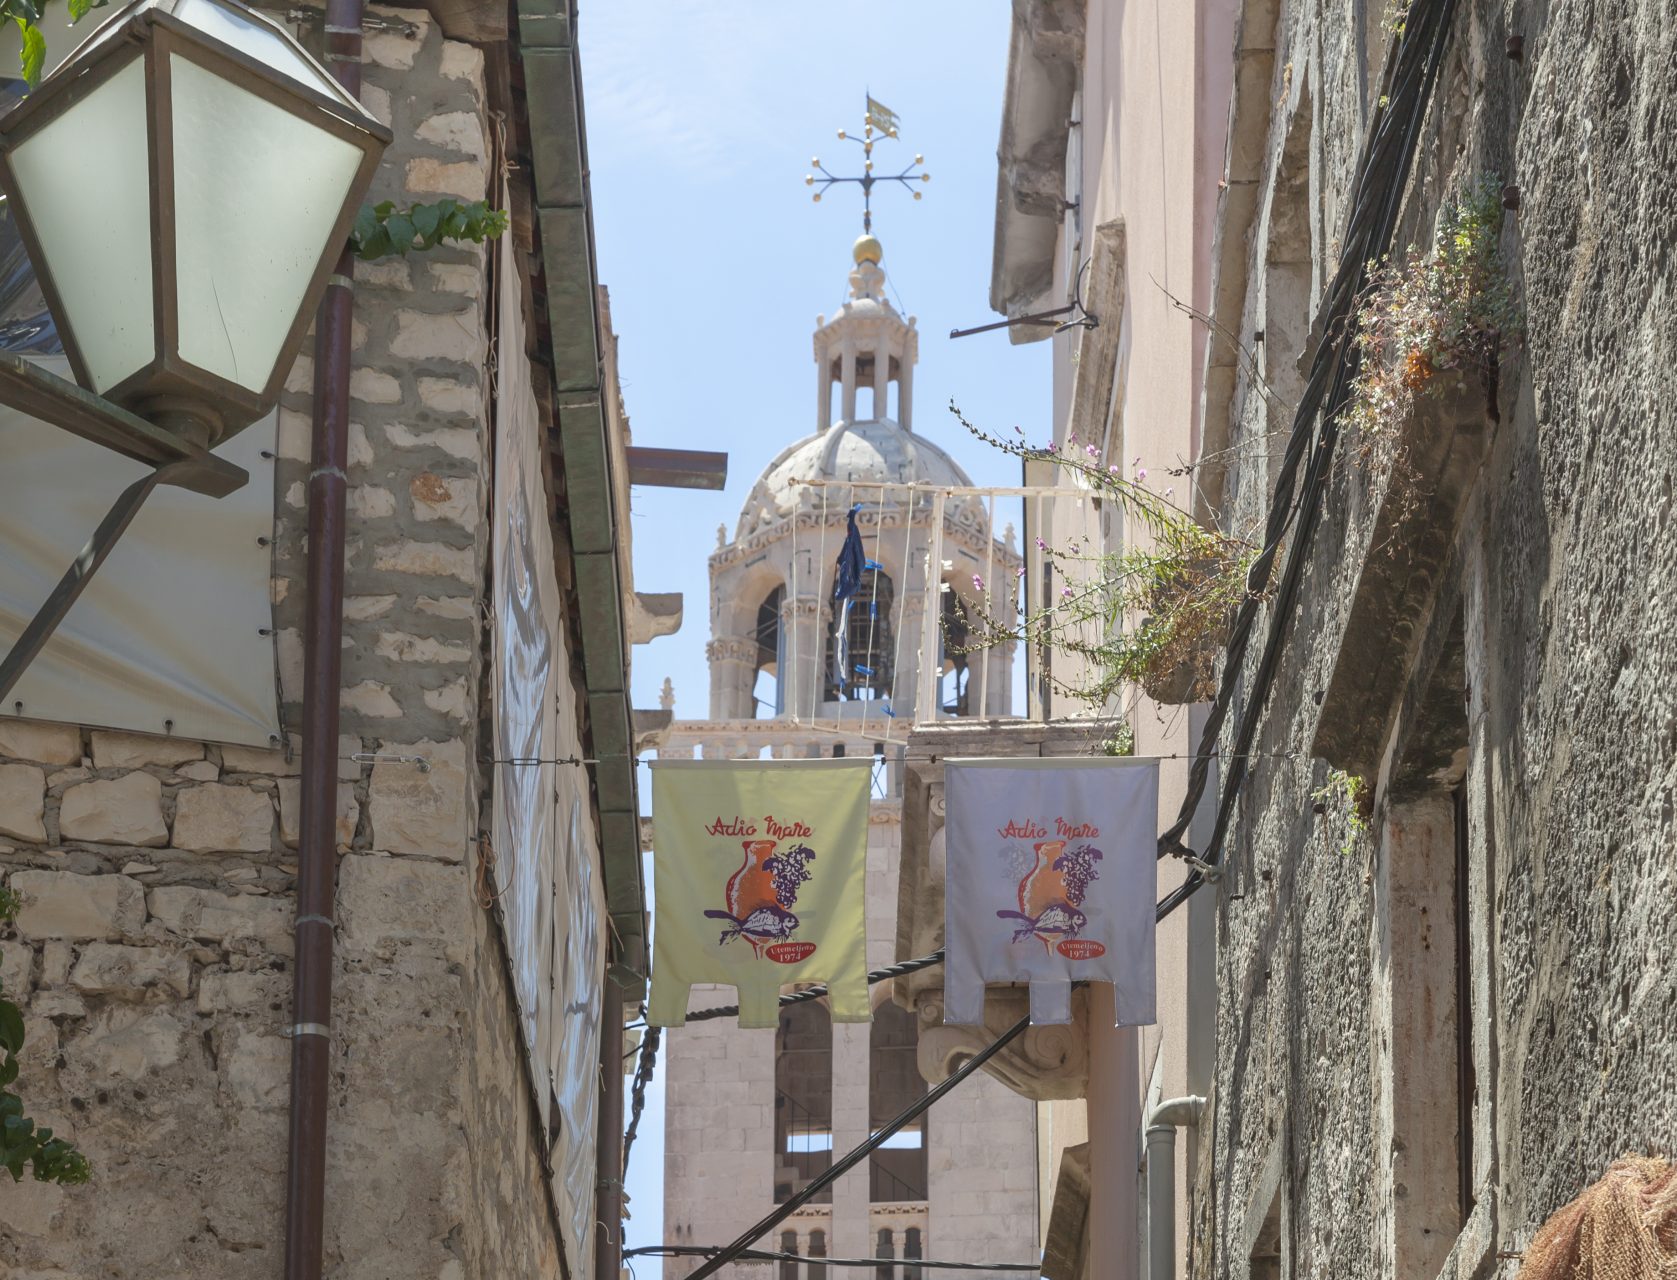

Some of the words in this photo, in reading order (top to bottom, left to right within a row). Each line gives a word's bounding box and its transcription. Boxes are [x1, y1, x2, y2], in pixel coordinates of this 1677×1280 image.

[705, 815, 757, 837] Adio
[764, 815, 814, 840] Mare
[997, 818, 1047, 839] Adio
[1054, 816, 1100, 840] Mare
[780, 953, 801, 962] 1974
